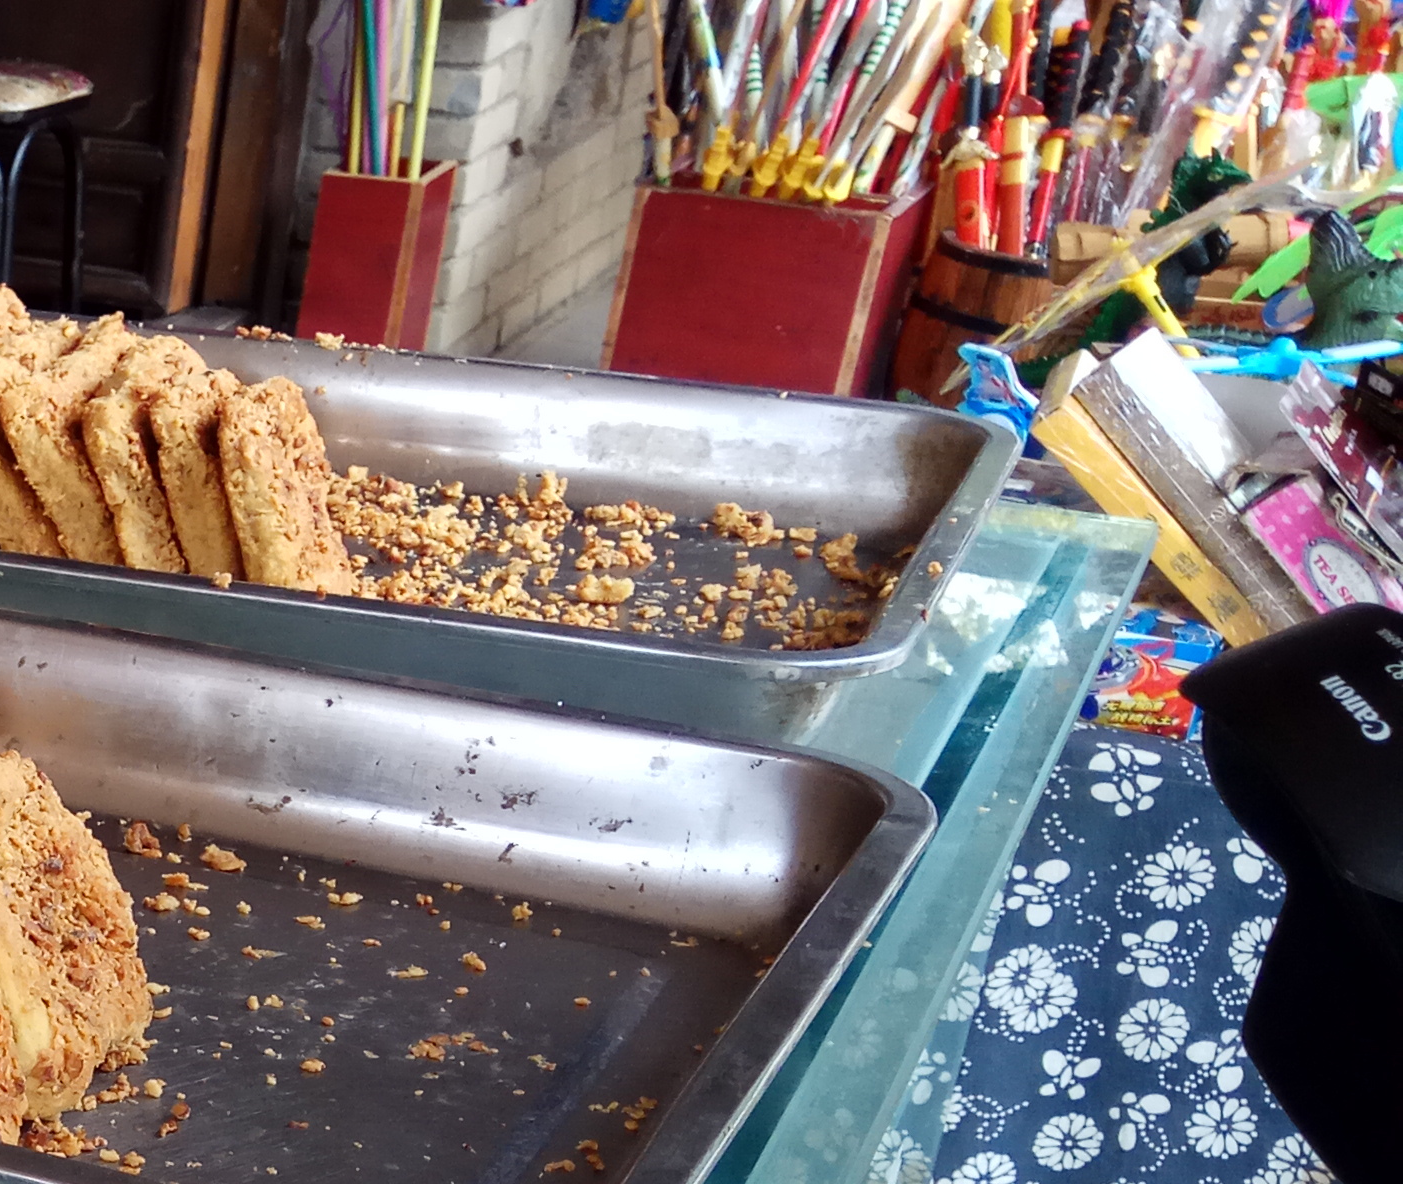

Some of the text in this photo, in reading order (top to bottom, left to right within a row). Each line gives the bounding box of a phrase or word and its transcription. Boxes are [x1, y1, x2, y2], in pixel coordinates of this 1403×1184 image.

[1314, 554, 1358, 604] TEA SE
[1319, 675, 1392, 741] Canon
